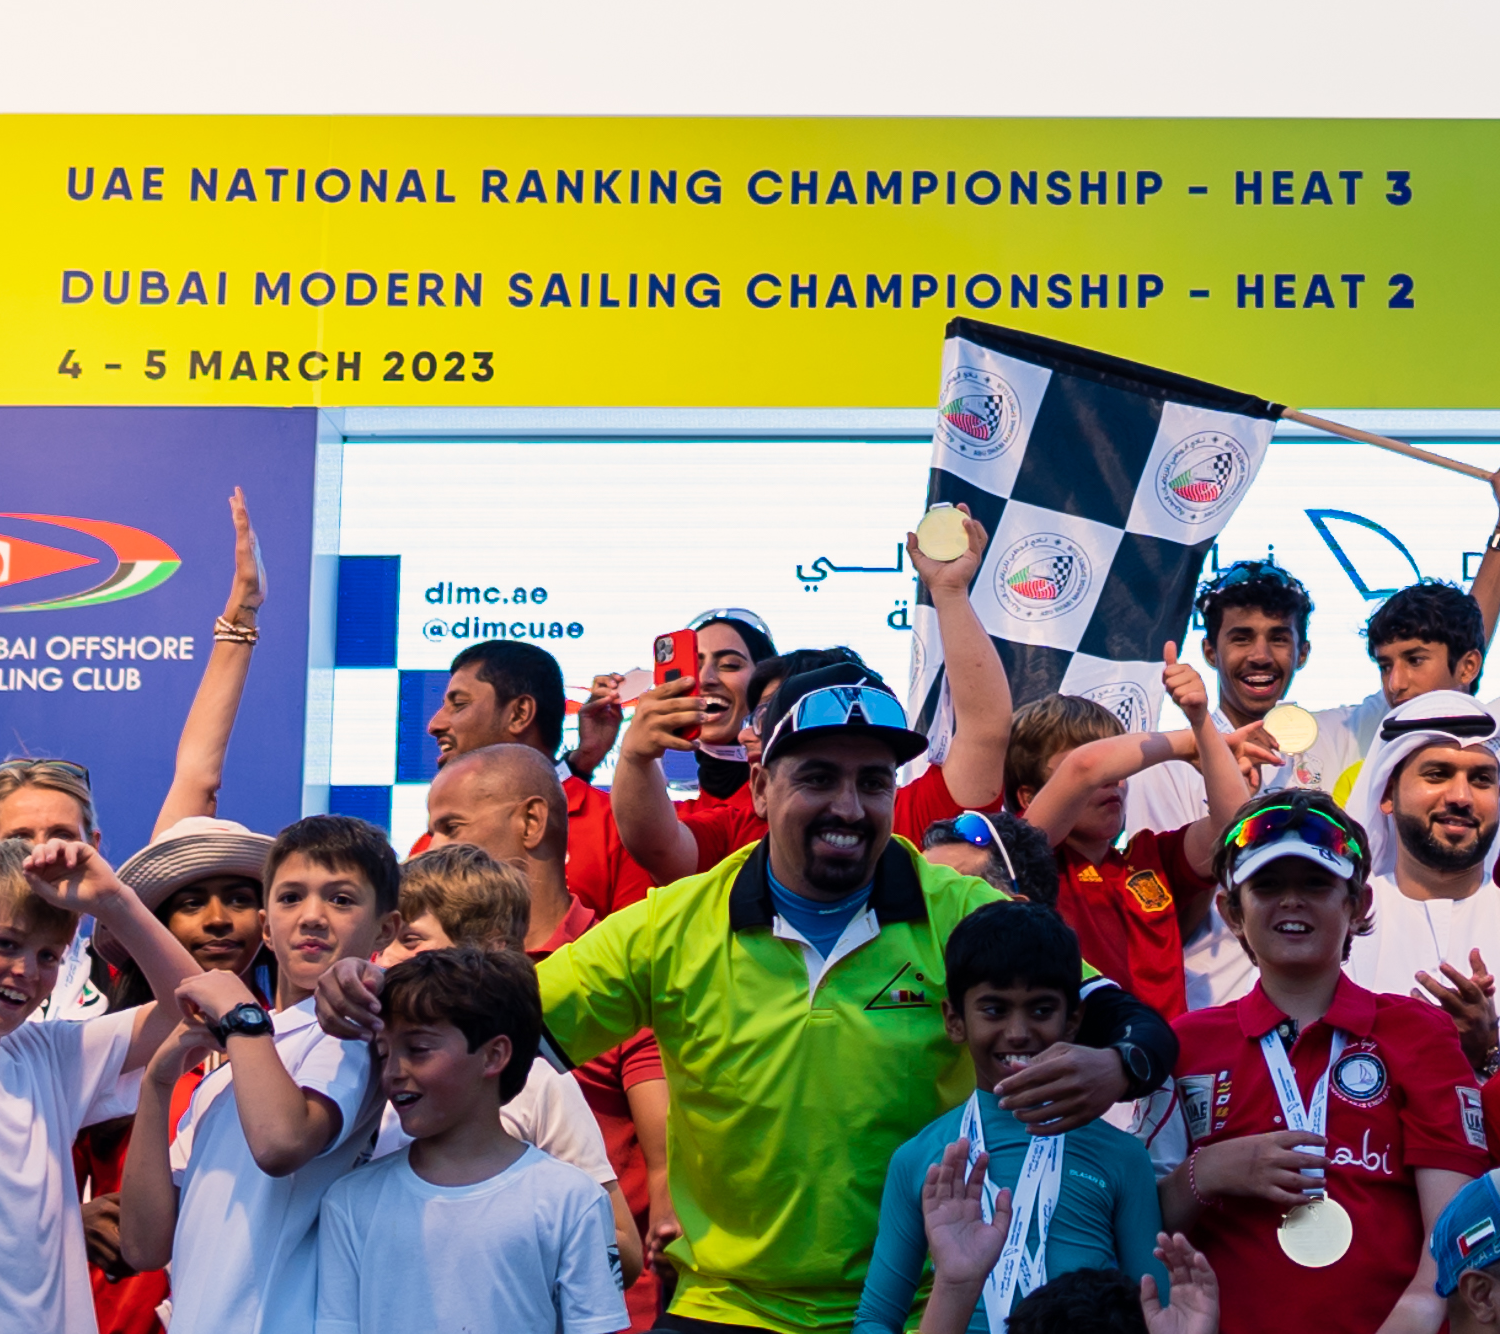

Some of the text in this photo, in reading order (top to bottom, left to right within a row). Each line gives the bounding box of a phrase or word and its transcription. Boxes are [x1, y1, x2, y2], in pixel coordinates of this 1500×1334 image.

[68, 167, 164, 200] UAE
[191, 168, 455, 203] NATIONAL
[482, 169, 721, 205] RANKING
[747, 170, 1163, 206] CHAMPIONSHIP
[1235, 170, 1363, 205] HEAT
[1385, 170, 1412, 206] 3
[62, 271, 228, 305] DUBAI
[255, 272, 482, 307] MODERN
[508, 272, 720, 308] SAILING
[746, 273, 1164, 309] CHAMPIONSHIP
[1237, 274, 1366, 309] HEAT
[1388, 273, 1415, 309] 2
[57, 349, 84, 381] 4
[144, 350, 167, 380] 5
[190, 351, 362, 382] MARCH
[383, 351, 495, 383] 2023
[424, 582, 549, 605] dimc.ae
[422, 617, 585, 643] @dimcuae
[45, 635, 195, 661] OFFSHORE
[72, 666, 142, 692] CLUB
